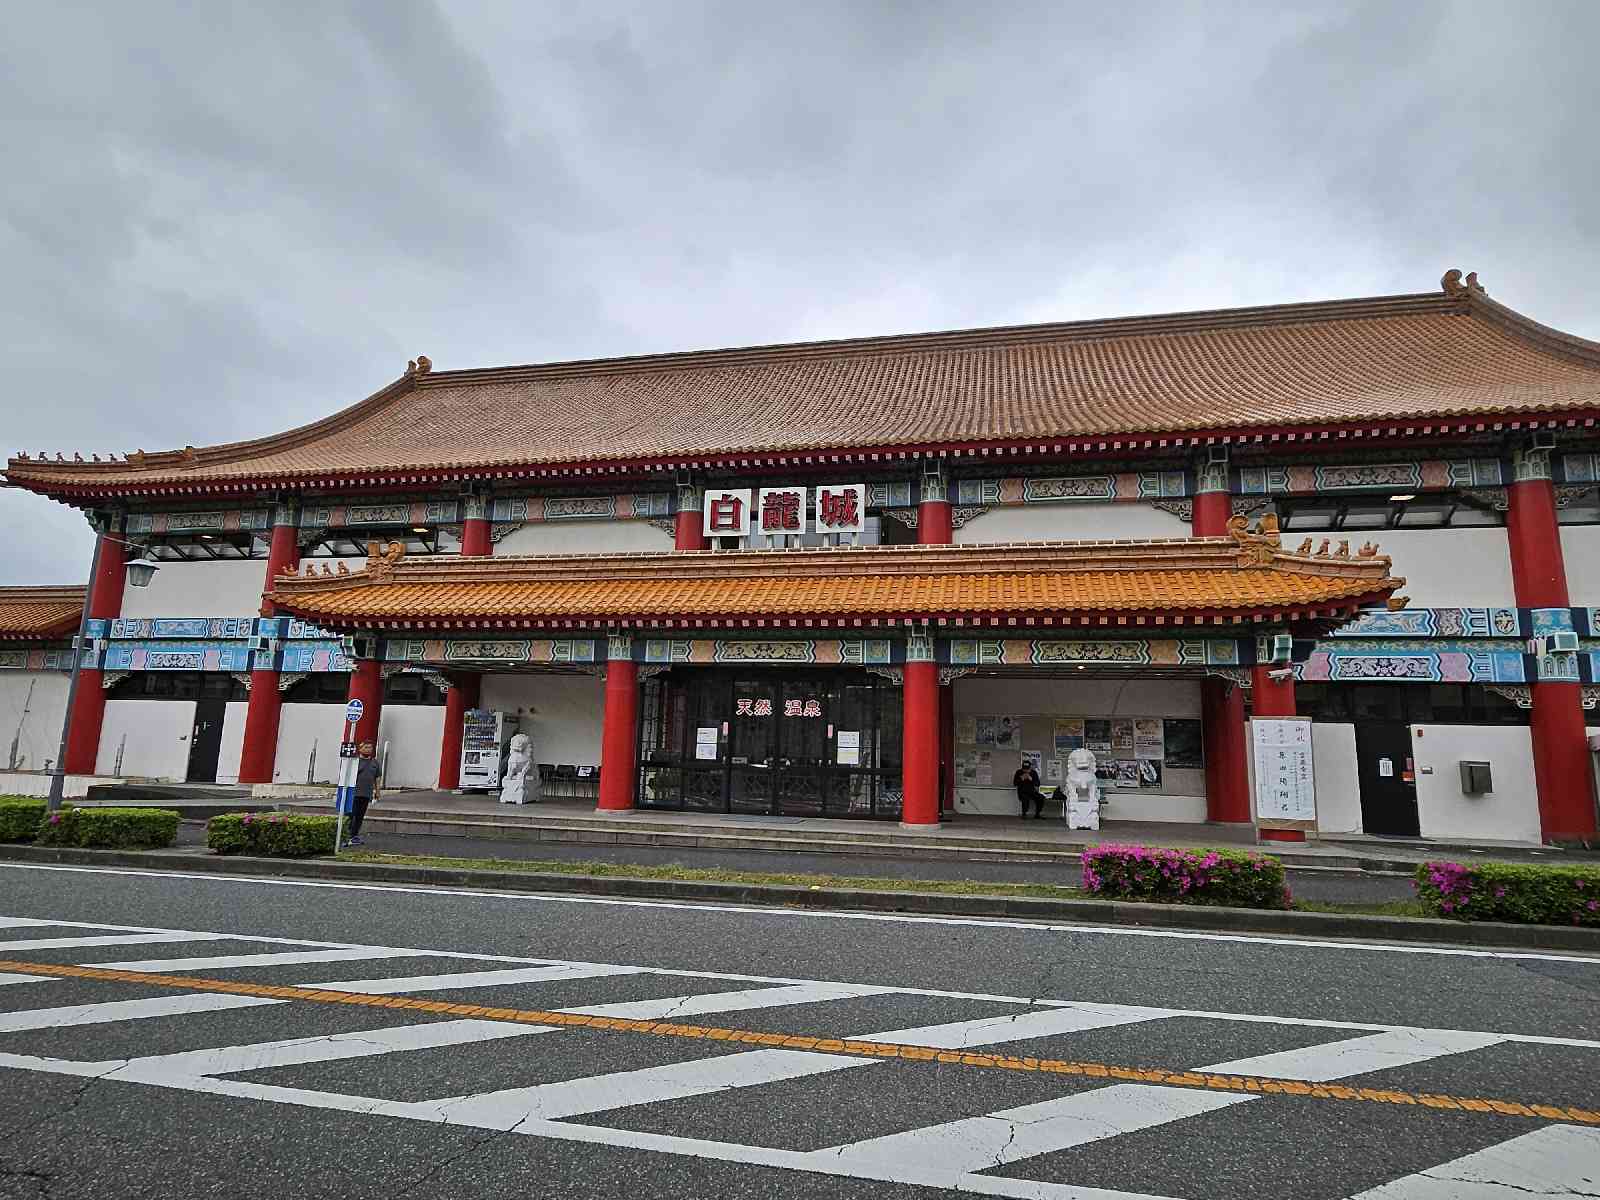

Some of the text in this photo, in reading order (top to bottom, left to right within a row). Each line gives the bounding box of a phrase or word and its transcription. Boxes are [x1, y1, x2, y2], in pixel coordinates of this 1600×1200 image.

[710, 488, 860, 531] 白龍城
[735, 698, 822, 717] 天然 温泉
